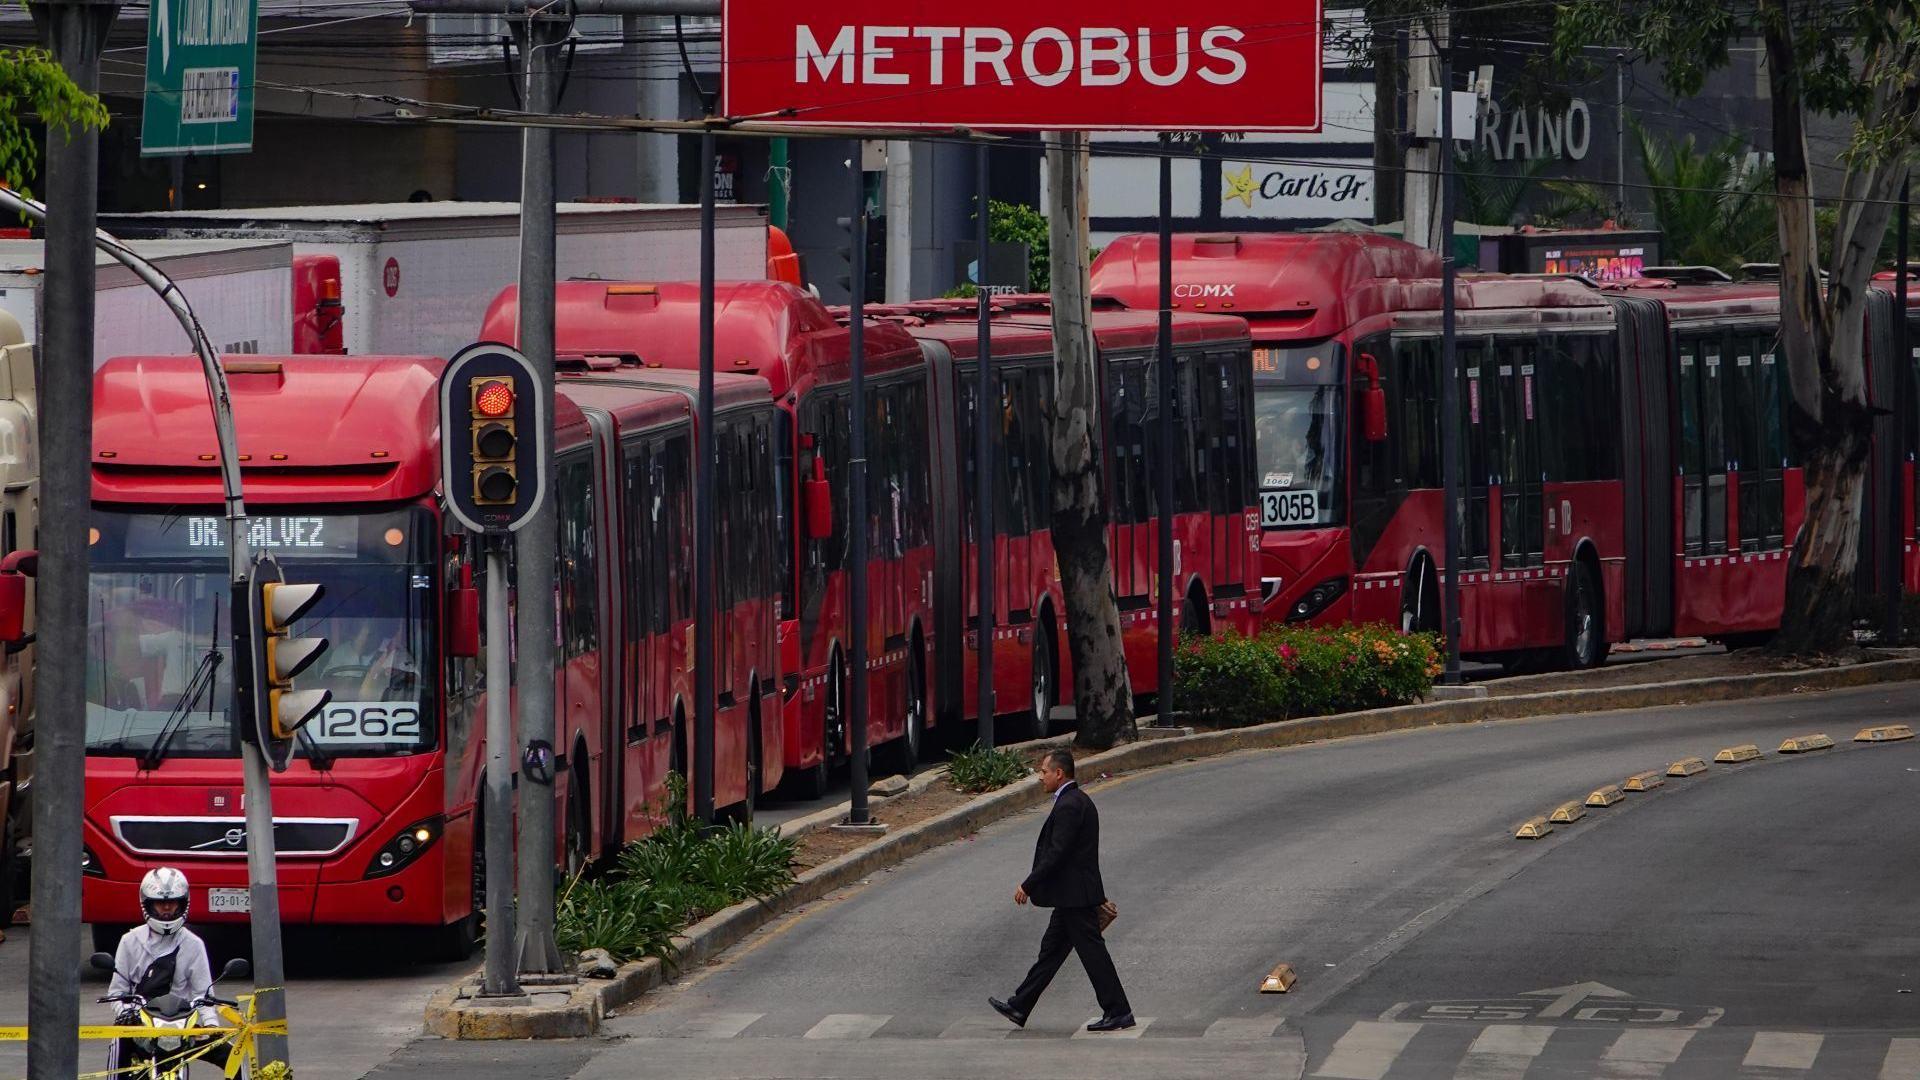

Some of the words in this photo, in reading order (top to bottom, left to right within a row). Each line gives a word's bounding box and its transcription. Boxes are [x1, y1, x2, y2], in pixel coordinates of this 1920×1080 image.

[795, 24, 1248, 87] METROBUS
[1454, 98, 1591, 163] RANO
[1259, 171, 1330, 200] Carl's
[1330, 173, 1370, 202] Jr.
[1174, 283, 1237, 298] CDMX
[1260, 493, 1315, 523] 1305B
[189, 517, 225, 547] DR.
[319, 707, 420, 738] 1262
